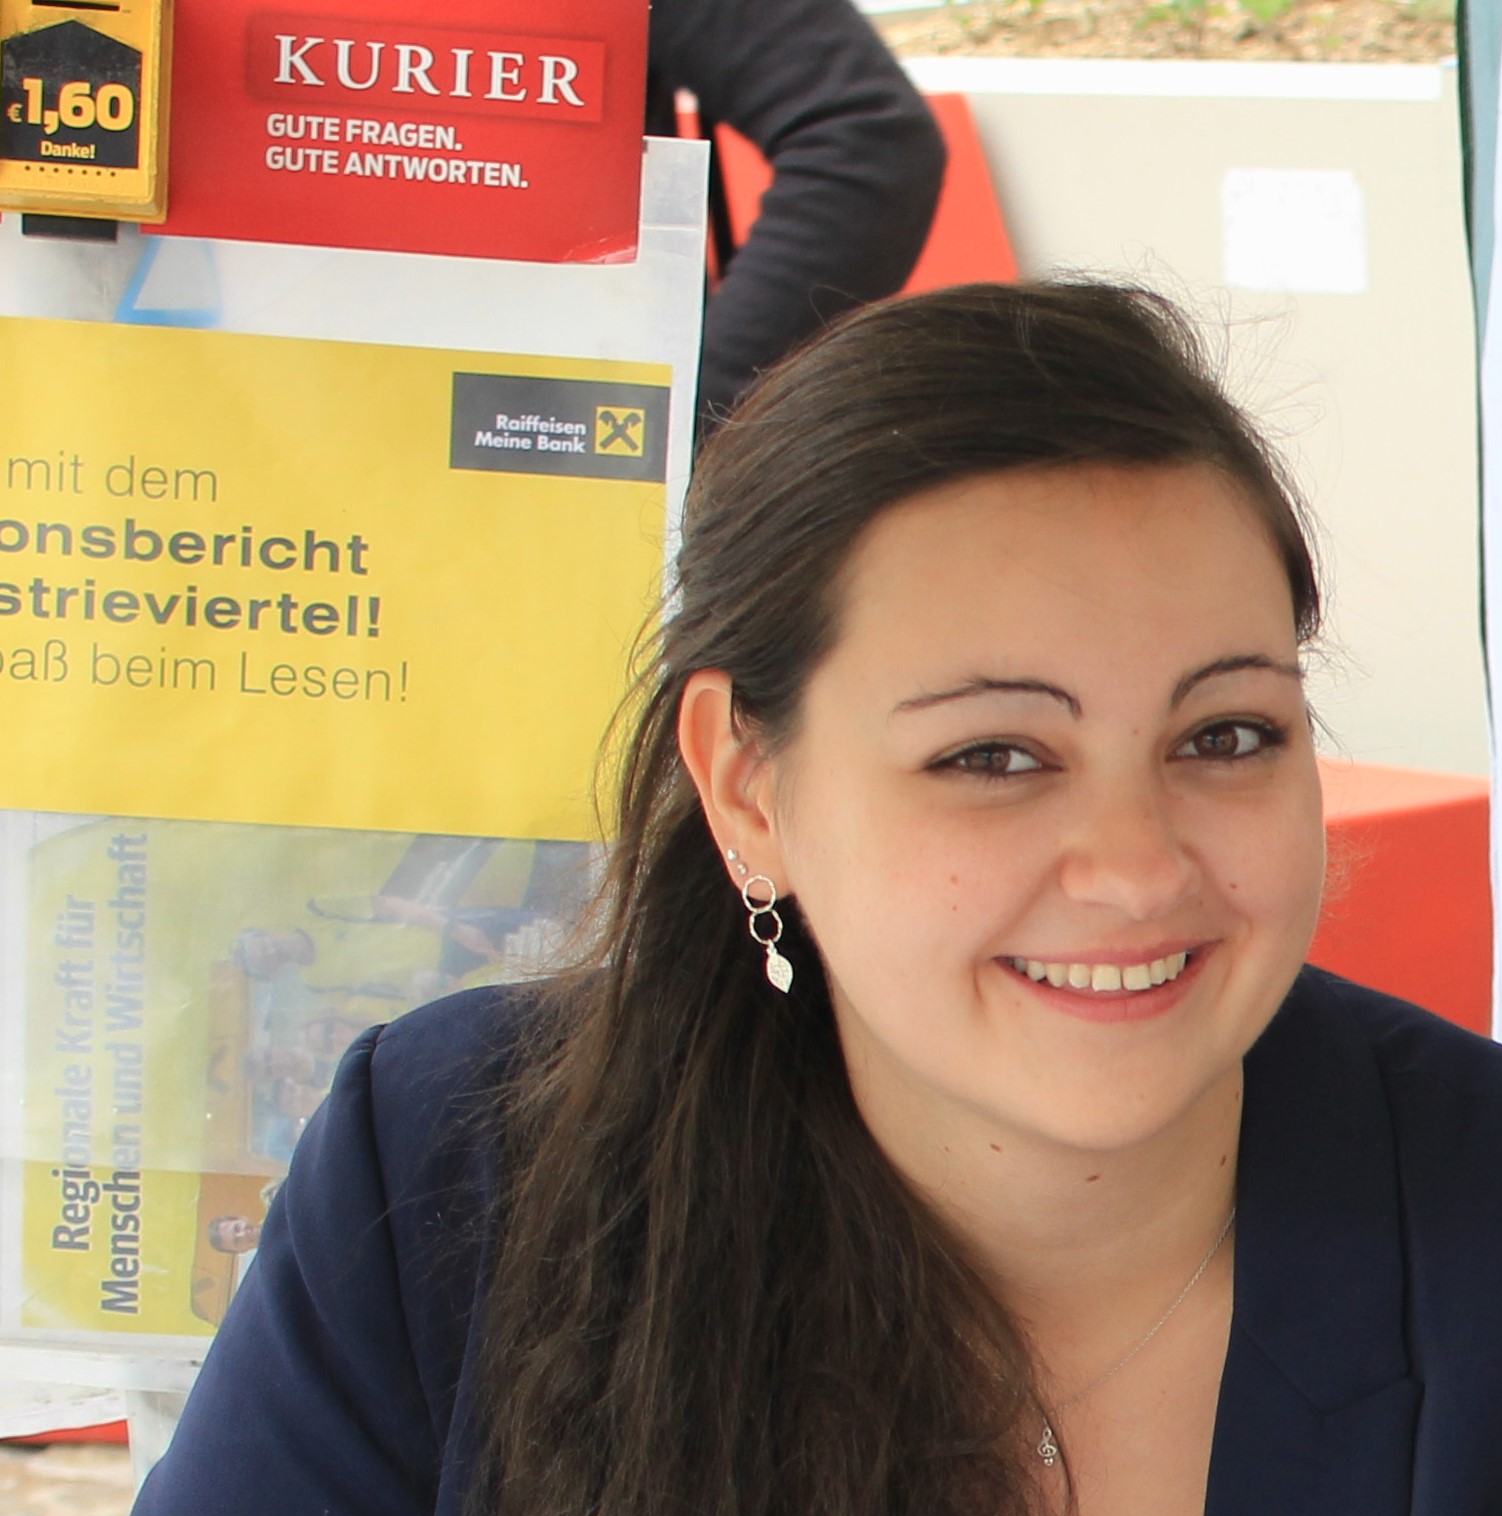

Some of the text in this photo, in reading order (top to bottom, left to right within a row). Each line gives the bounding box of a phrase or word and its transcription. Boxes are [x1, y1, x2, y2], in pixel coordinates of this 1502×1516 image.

[273, 34, 585, 107] KURIER
[40, 140, 96, 160] Danke!
[266, 113, 463, 151] GUTE FRAGEN.
[265, 146, 529, 188] GUTE ANTWORTEN.
[474, 431, 586, 454] Meine Bank
[496, 414, 587, 436] Raiffeisen
[8, 450, 218, 503] mit dem
[0, 638, 407, 702] aß beim Lesen!
[51, 893, 100, 1251] Regionale Kraft für
[100, 832, 148, 1315] Menschen und Wirtschaft
